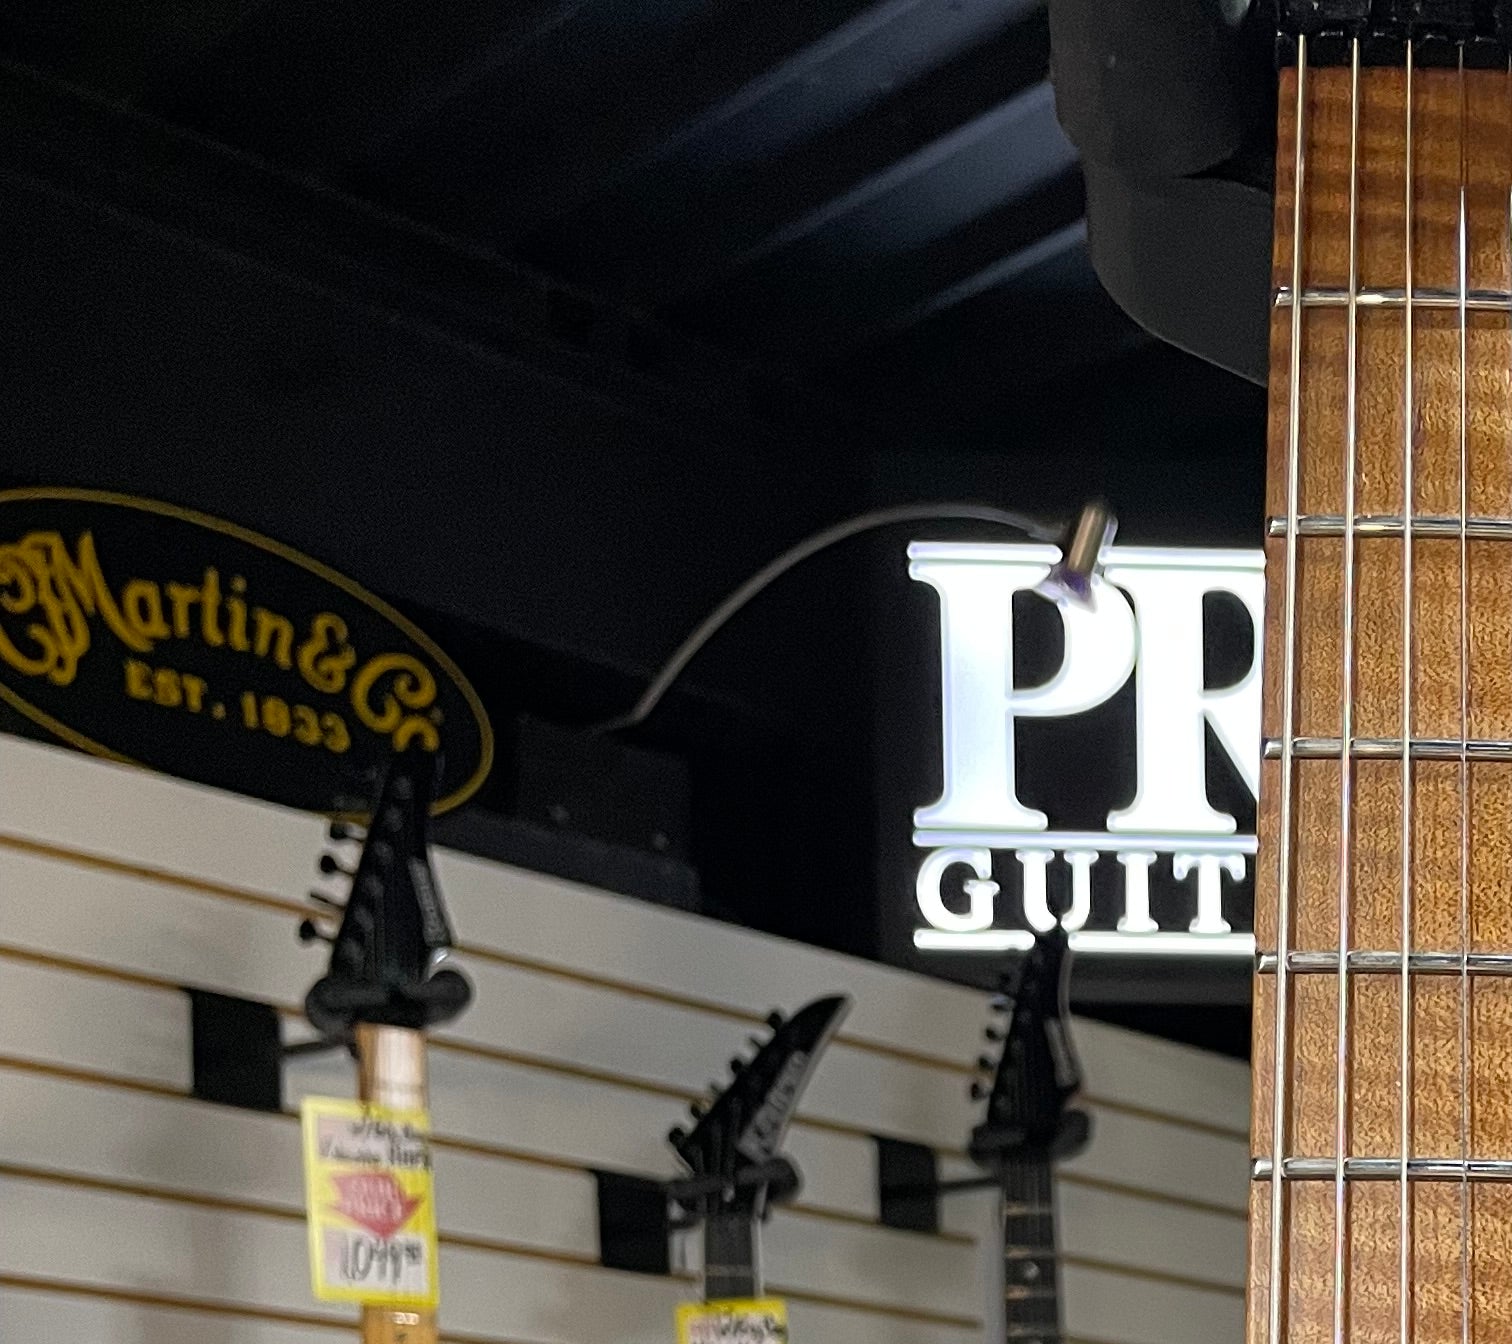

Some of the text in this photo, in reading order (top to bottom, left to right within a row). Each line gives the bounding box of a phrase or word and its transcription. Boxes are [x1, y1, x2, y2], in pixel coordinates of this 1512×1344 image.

[123, 658, 227, 720] EST.
[908, 562, 1264, 833] PR
[915, 847, 1247, 935] GUIT
